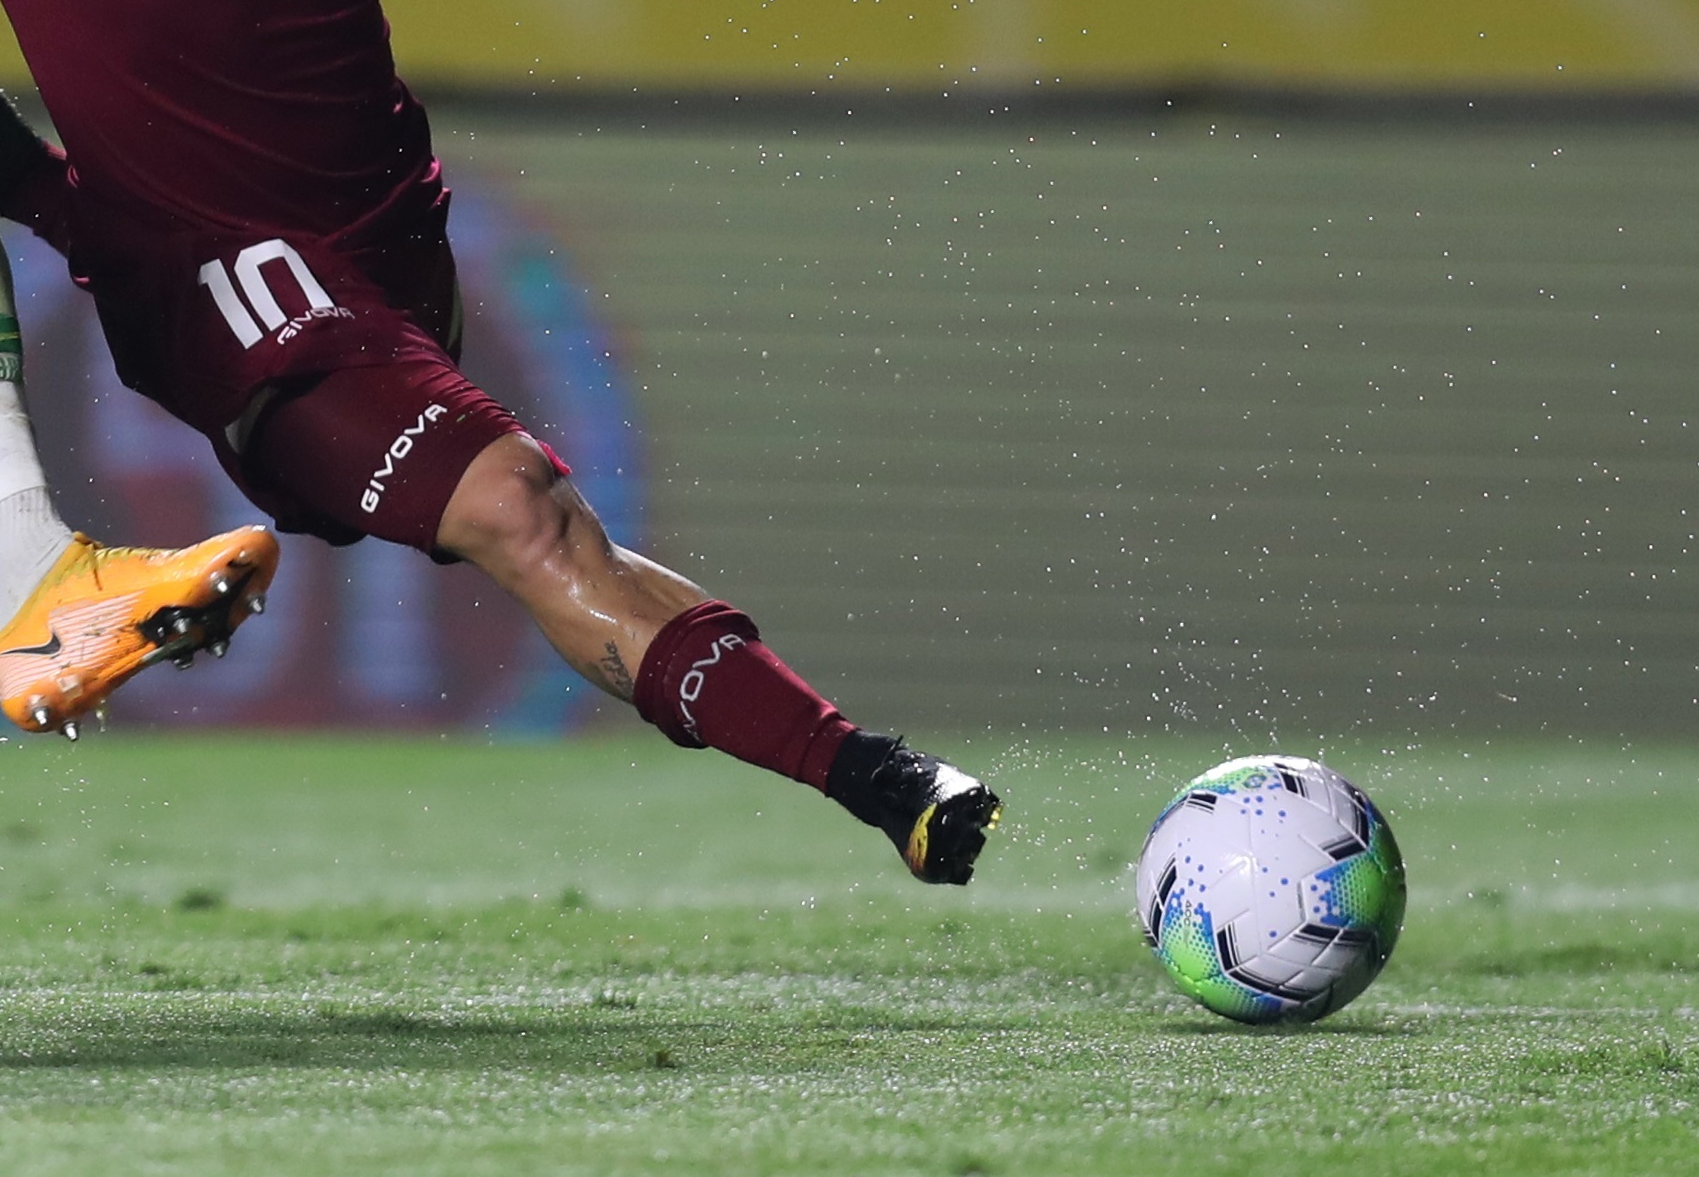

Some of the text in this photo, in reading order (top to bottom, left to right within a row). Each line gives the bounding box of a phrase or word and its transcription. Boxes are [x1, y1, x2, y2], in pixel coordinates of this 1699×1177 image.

[197, 238, 335, 350] 10
[277, 307, 355, 345] GIVOVA
[360, 403, 448, 513] GIVOVA
